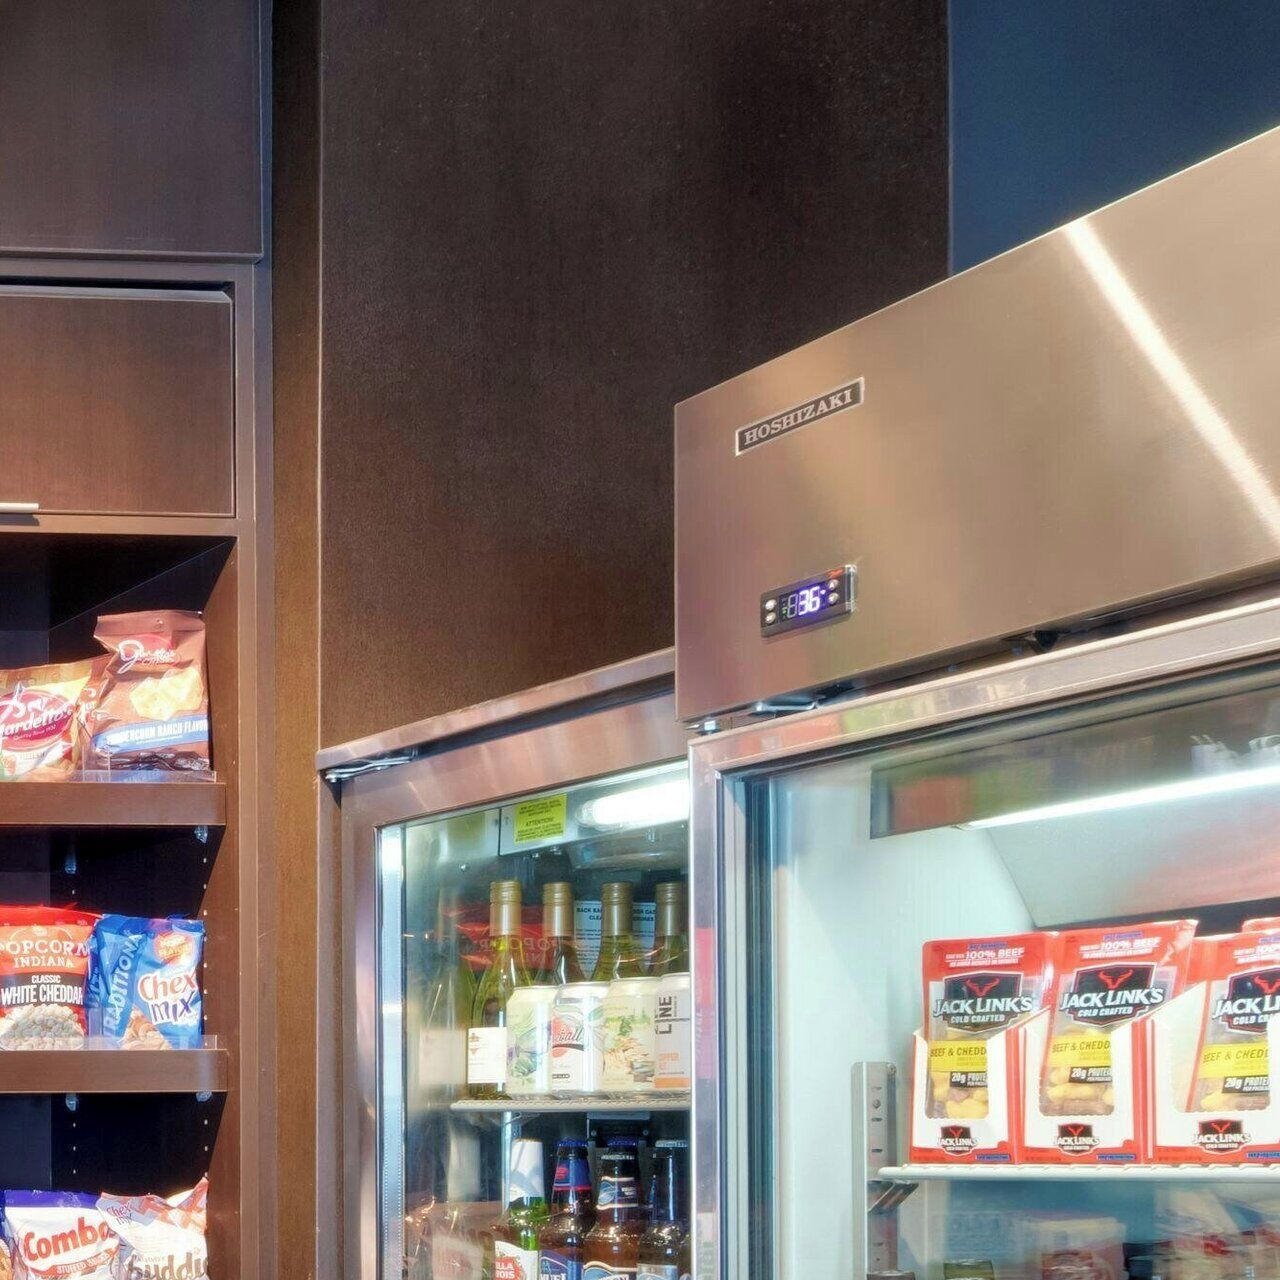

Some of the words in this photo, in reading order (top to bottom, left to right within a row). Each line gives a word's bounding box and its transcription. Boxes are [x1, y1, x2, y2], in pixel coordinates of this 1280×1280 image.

[744, 388, 853, 446] HOSHIZAKI
[157, 722, 183, 737] RANCH
[1101, 939, 1132, 950] 100%
[1134, 937, 1160, 949] BEEF
[965, 949, 996, 960] 100%
[998, 947, 1025, 959] BEEF
[14, 955, 75, 969] INDIANA
[31, 974, 61, 984] CLASSIC
[138, 971, 197, 1002] Chex
[0, 986, 39, 1006] WHITE
[1060, 991, 1102, 1009] JACK
[1106, 987, 1164, 1006] LINK'S
[933, 998, 973, 1016] JACK
[977, 995, 1033, 1013] LINK'S
[1078, 1007, 1097, 1018] COLD
[1098, 1006, 1133, 1017] CRAFTED
[1215, 998, 1258, 1017] JACK
[951, 1014, 970, 1024] COLD
[972, 1013, 1006, 1023] CRAFTED
[1233, 1015, 1252, 1025] COLD
[930, 1045, 947, 1058] BEEF
[1052, 1041, 1070, 1054] BEEF
[1203, 1050, 1223, 1064] BEEF
[939, 1136, 954, 1146] JACK
[954, 1136, 979, 1146] LINK'S
[1054, 1136, 1071, 1146] JACK
[1072, 1135, 1098, 1145] LINK'S
[1193, 1134, 1214, 1144] JACK
